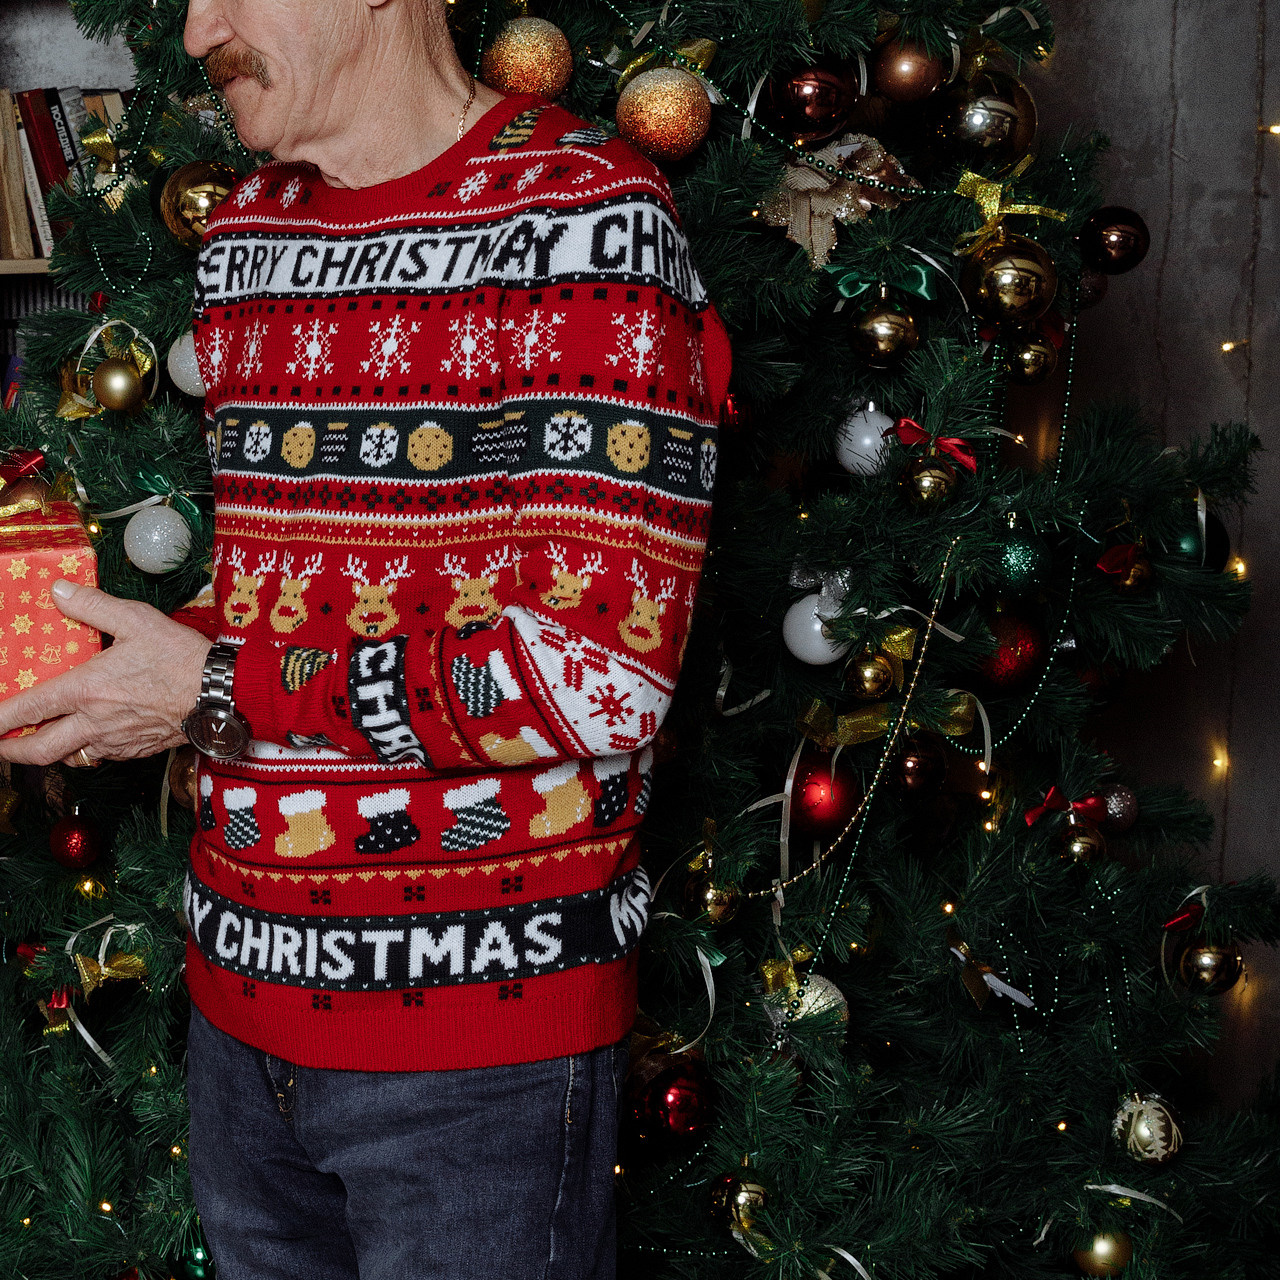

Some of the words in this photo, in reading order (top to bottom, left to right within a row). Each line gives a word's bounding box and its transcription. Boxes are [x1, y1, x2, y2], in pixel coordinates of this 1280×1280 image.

[49, 104, 74, 162] ПОСЛЕДНЕЕ
[196, 240, 288, 295] ERRY
[214, 910, 564, 983] CHRISTMAS
